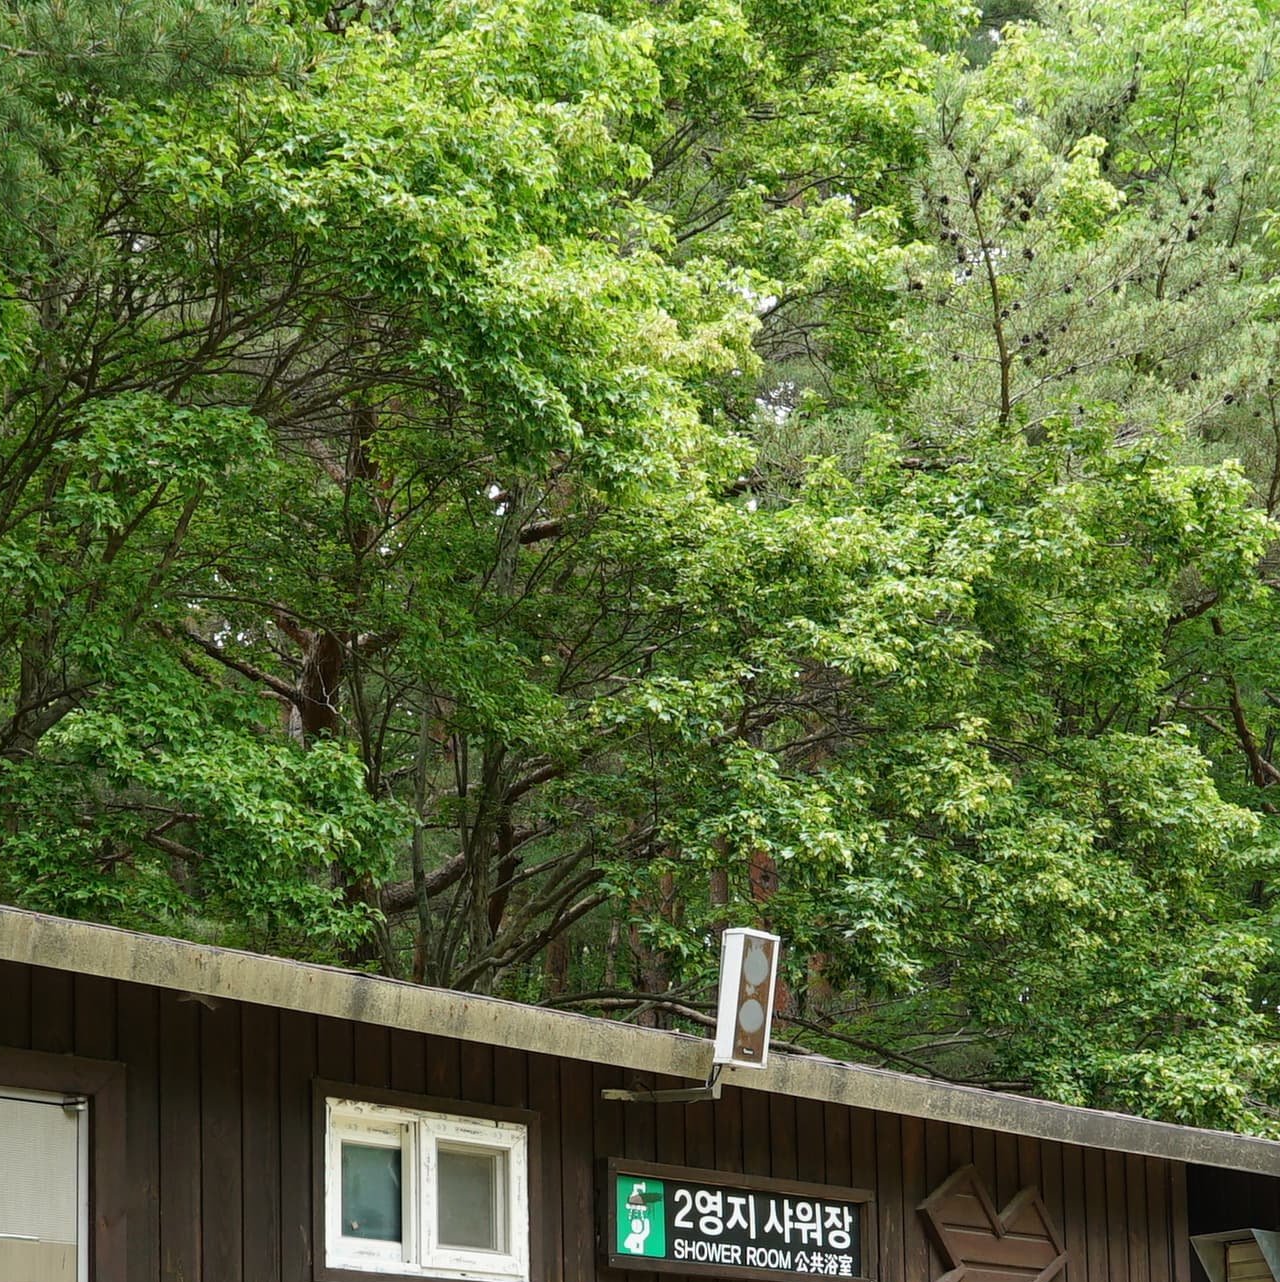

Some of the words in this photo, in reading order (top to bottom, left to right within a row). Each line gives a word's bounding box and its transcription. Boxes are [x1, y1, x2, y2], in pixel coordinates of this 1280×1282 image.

[673, 1187, 757, 1240] 2영지
[763, 1198, 853, 1250] 샤워장
[673, 1238, 742, 1265] SHOWER
[745, 1246, 792, 1270] ROOM
[794, 1250, 853, 1277] 公共浴室
